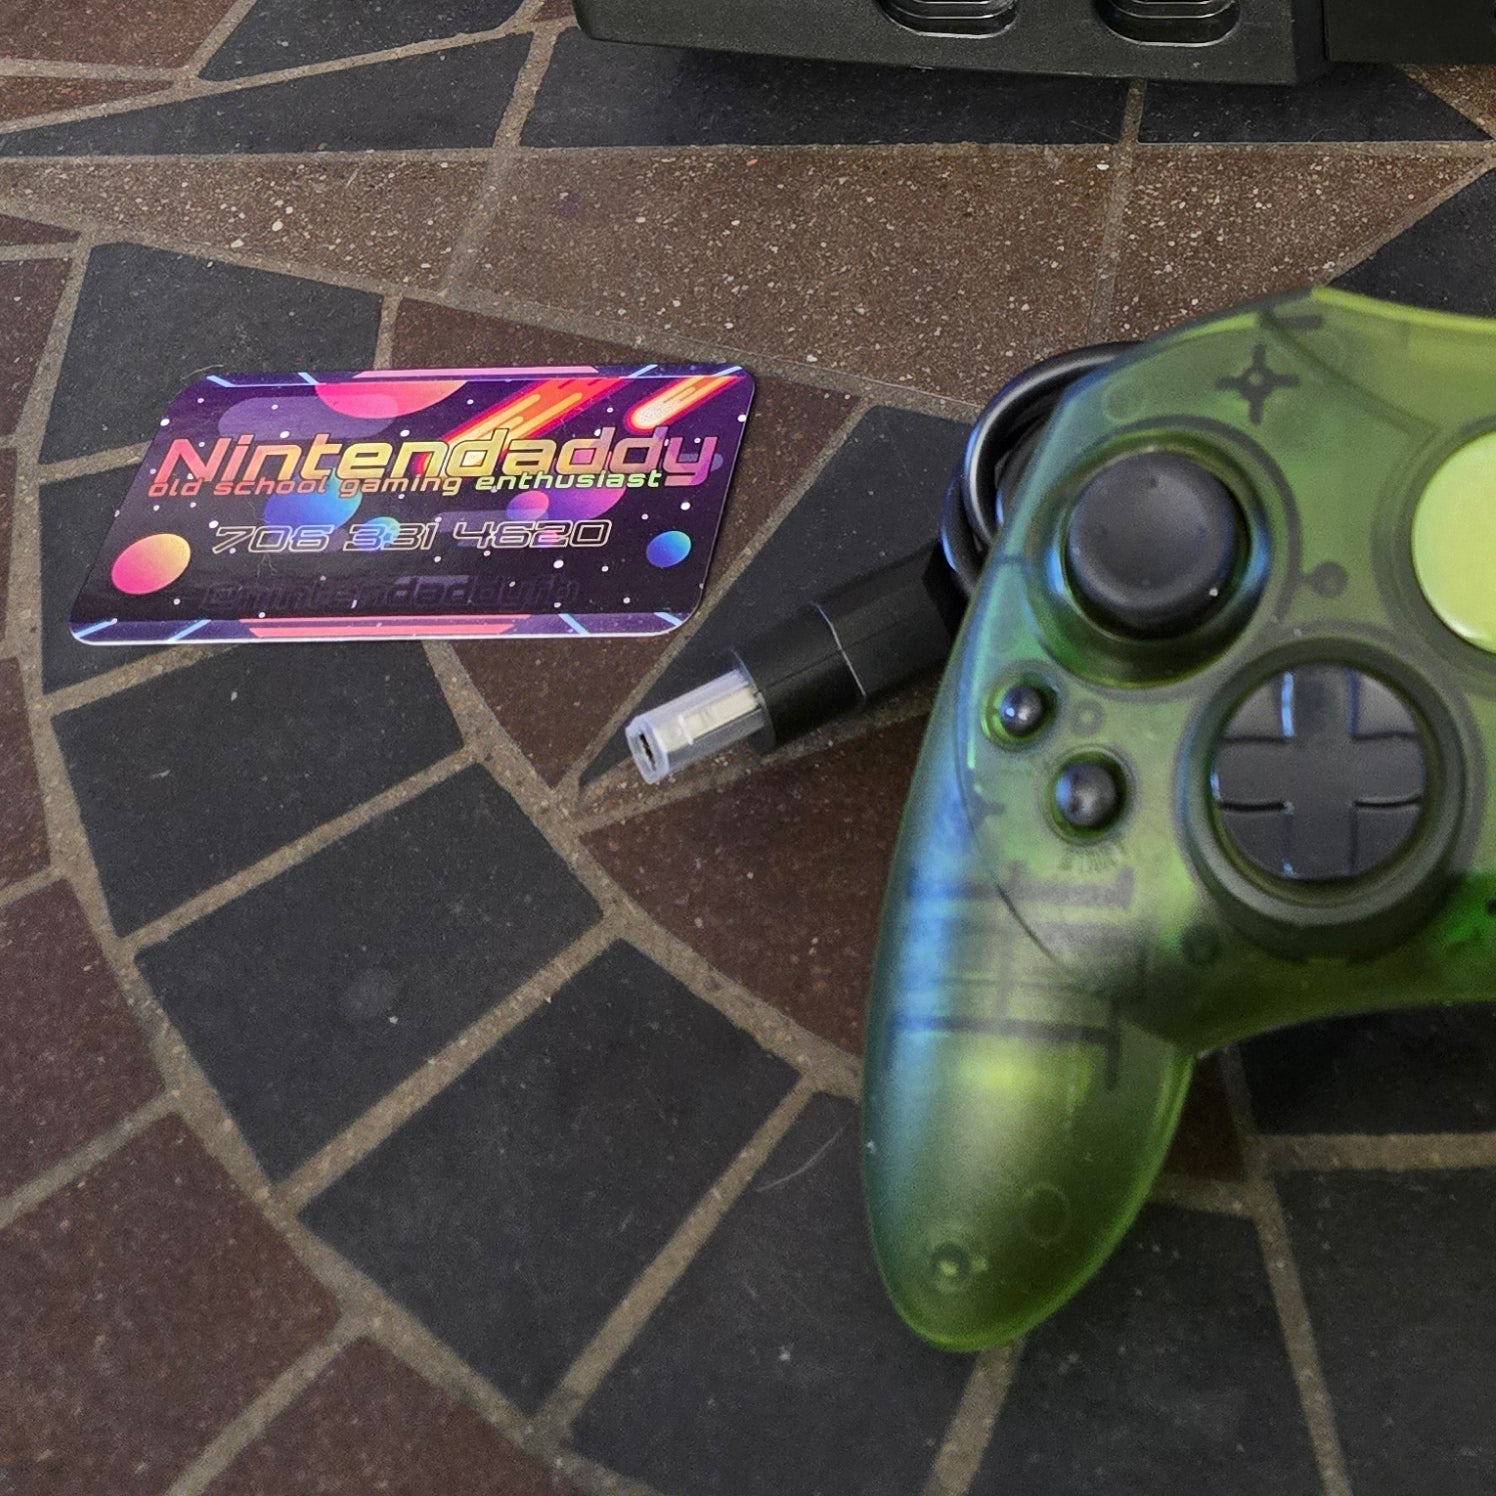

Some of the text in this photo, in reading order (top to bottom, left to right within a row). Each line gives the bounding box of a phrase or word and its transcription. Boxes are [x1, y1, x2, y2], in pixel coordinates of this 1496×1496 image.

[155, 427, 718, 488] Nintendaddy
[147, 468, 663, 499] old school gaming enthusiast
[211, 517, 613, 555] 706 331 4620
